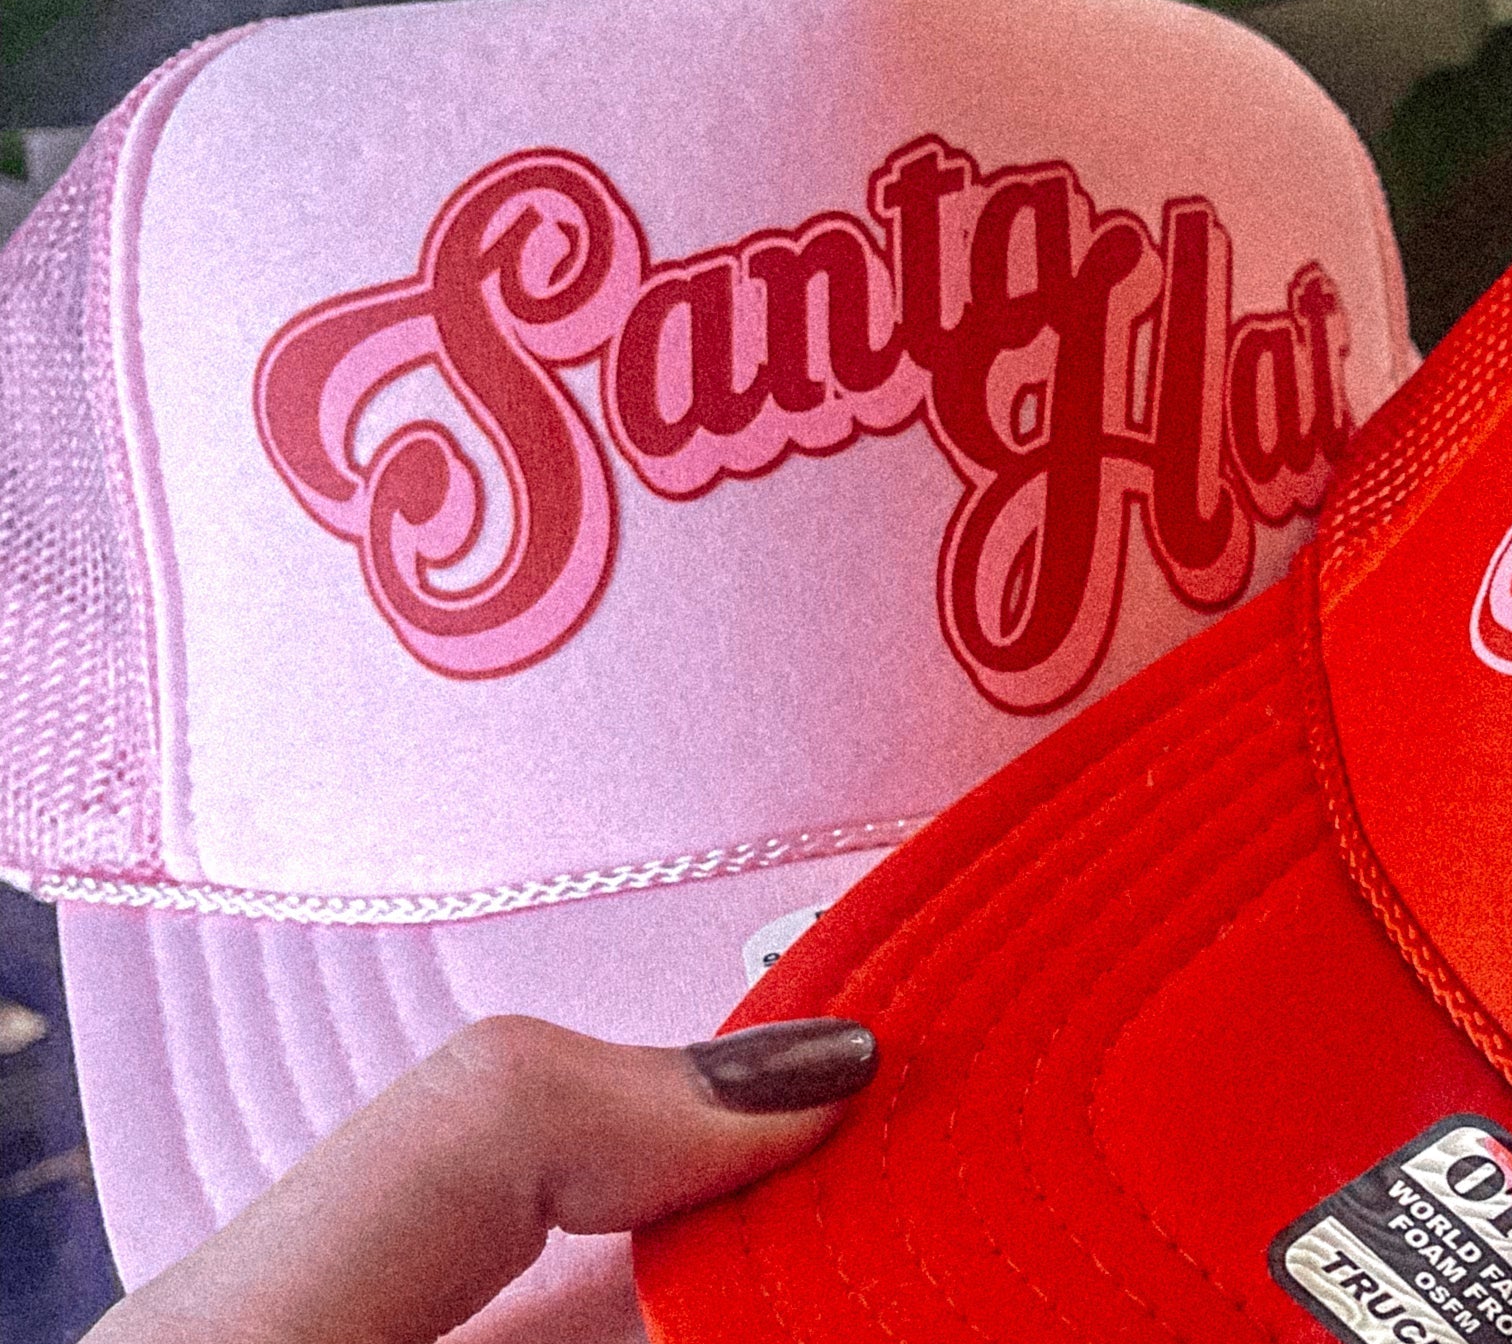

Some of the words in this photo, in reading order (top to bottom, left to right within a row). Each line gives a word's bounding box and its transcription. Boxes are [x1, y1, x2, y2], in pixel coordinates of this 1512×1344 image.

[253, 133, 1094, 679] Santa
[934, 196, 1352, 716] Hat
[1387, 1179, 1481, 1263] WORLD
[1387, 1215, 1462, 1285] FOAM
[1413, 1270, 1482, 1335] OSFM
